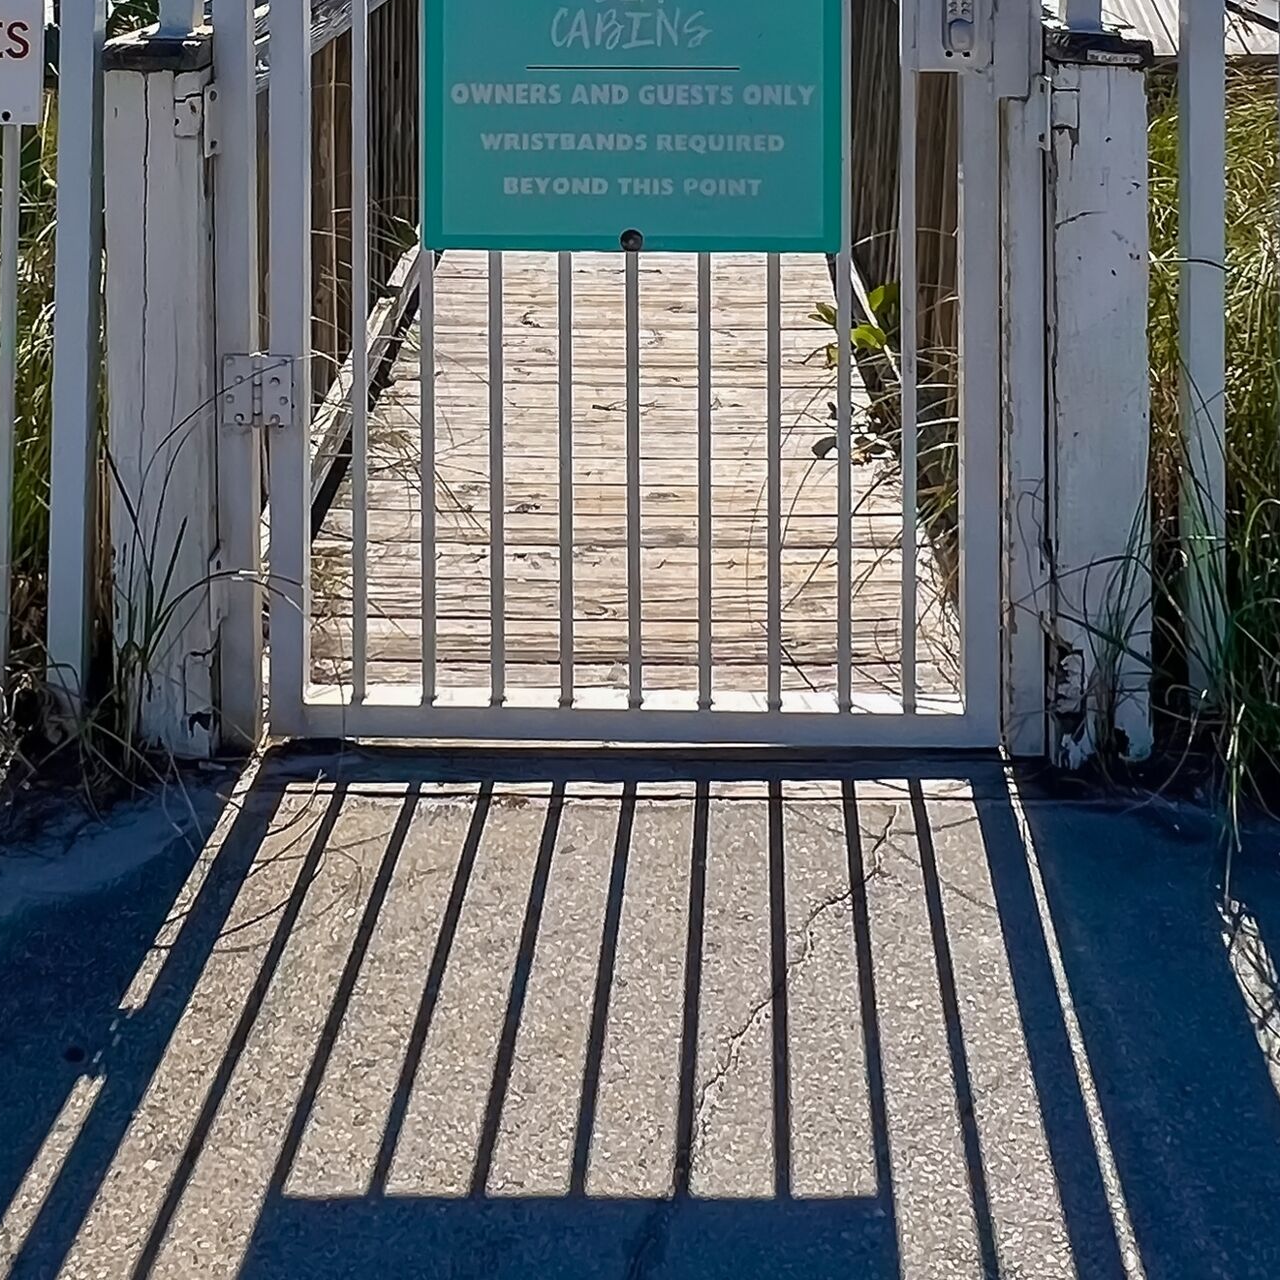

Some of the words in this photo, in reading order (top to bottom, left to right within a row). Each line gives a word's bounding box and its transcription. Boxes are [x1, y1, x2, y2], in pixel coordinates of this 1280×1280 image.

[550, 7, 714, 50] CABINS
[450, 82, 562, 105] OWNERS
[571, 83, 629, 105] AND
[639, 84, 734, 106] GUESTS
[743, 84, 817, 106] ONLY
[480, 132, 647, 151] WRISTBANDS
[657, 133, 785, 154] REQUIRED
[503, 176, 608, 196] BEYOND
[618, 177, 674, 196] THIS
[683, 177, 762, 197] POINT
